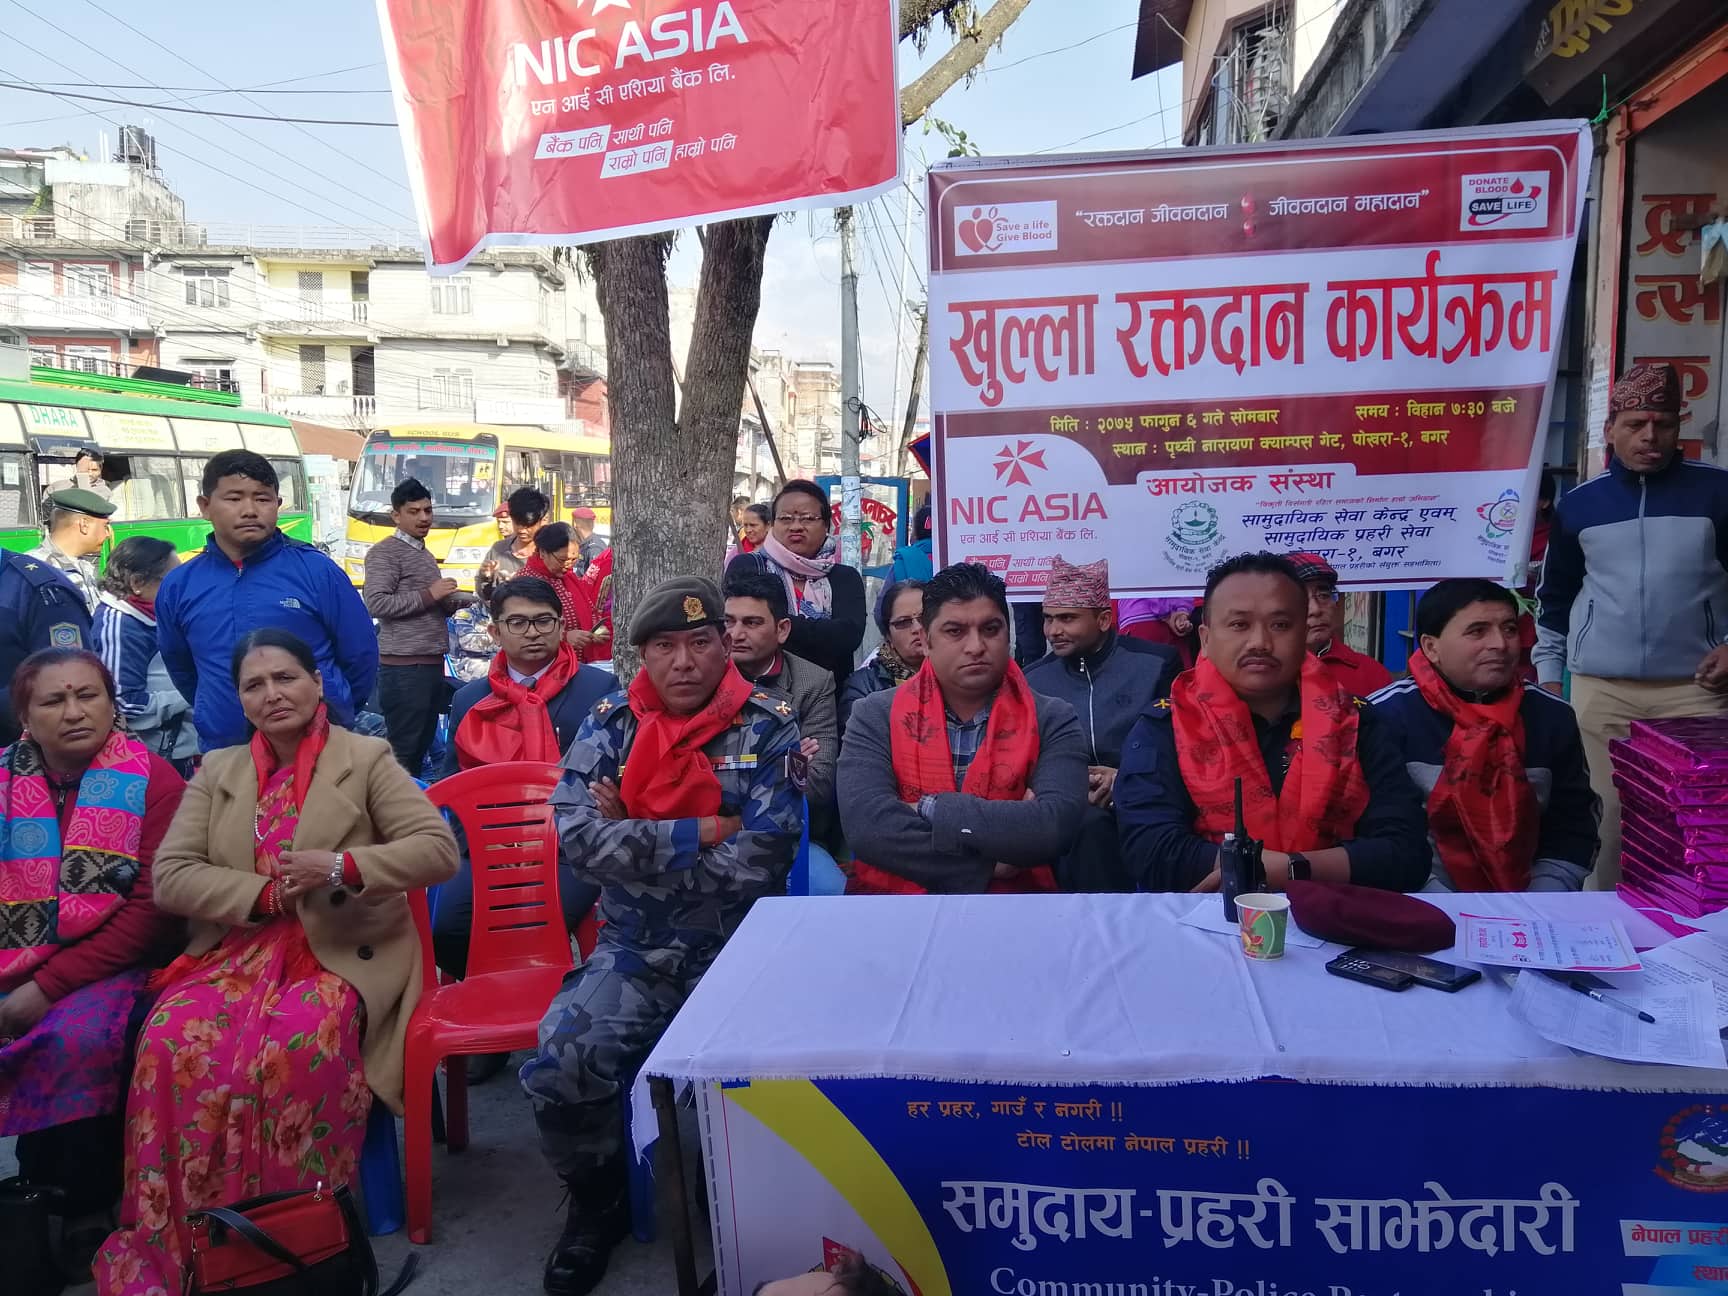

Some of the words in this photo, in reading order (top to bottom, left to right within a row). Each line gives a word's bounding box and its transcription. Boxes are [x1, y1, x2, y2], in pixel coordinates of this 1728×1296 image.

[514, 28, 601, 85] NIC
[614, 1, 749, 69] ASIA
[531, 99, 556, 115] एन
[562, 87, 590, 112] आई
[595, 85, 614, 105] सी
[618, 76, 665, 101] एशिया
[670, 67, 703, 89] बैंक
[708, 63, 736, 83] लि.
[544, 136, 575, 154] बैंक
[612, 124, 645, 145] साथी
[648, 118, 675, 137] पनि
[609, 152, 637, 170] राम्रो
[674, 137, 707, 161] हाम्रो
[710, 133, 739, 152] पनि
[1468, 177, 1509, 186] DONATE
[1475, 185, 1509, 194] BLOOD
[1151, 203, 1229, 224] जीवनदान
[1269, 196, 1348, 216] जीवनदान
[1471, 202, 1501, 212] SAVE
[1506, 200, 1533, 210] LIFE
[996, 222, 1021, 232] Save
[1023, 223, 1030, 231] a
[1032, 220, 1050, 230] life
[996, 231, 1020, 242] Give
[1022, 230, 1053, 241] Blood
[949, 294, 1098, 407] खुल्ला
[1115, 281, 1309, 378] रक्तदान
[1326, 250, 1558, 364] कार्यक्रम
[29, 404, 79, 428] DHARA
[1050, 415, 1080, 432] मिति
[1097, 416, 1134, 434] २०७५
[1139, 414, 1182, 432] फागुन
[1202, 408, 1225, 425] गते
[1112, 441, 1148, 458] स्थान
[1164, 436, 1197, 459] पृथ्वी
[1201, 437, 1255, 455] नारायण
[1420, 429, 1450, 446] बगर
[1146, 472, 1257, 497] आयोजक
[1268, 468, 1336, 495] संस्था
[951, 495, 1009, 526] NIC
[1018, 491, 1109, 523] ASIA
[1241, 508, 1328, 530] सामुदायिक
[1334, 507, 1367, 524] सेवा
[1372, 506, 1414, 523] केन्द्र
[1419, 506, 1459, 523] एवम्
[960, 533, 976, 545] एन
[979, 530, 1000, 545] आई
[1020, 529, 1051, 543] एशिया
[1264, 526, 1349, 547] सामुदायिक
[1354, 524, 1394, 542] प्रहरी
[1400, 523, 1434, 539] सेवा
[1372, 545, 1409, 560] बगर
[907, 1100, 931, 1119] हर
[938, 1100, 981, 1120] प्रहर,
[991, 1095, 1027, 1118] गाउँ
[1034, 1101, 1047, 1119] र
[1054, 1098, 1103, 1119] नगरी
[1017, 1129, 1052, 1149] टोल
[1060, 1131, 1116, 1152] टोलमा
[1124, 1132, 1176, 1153] नेपाल
[1184, 1134, 1229, 1157] प्रहरी
[941, 1177, 1297, 1250] समुदाय-प्रहरी
[1315, 1181, 1581, 1258] साझेदारी
[1631, 1223, 1682, 1244] नेपाल
[990, 1266, 1316, 1296] Community-Poli
[1692, 1265, 1728, 1281] स्था
